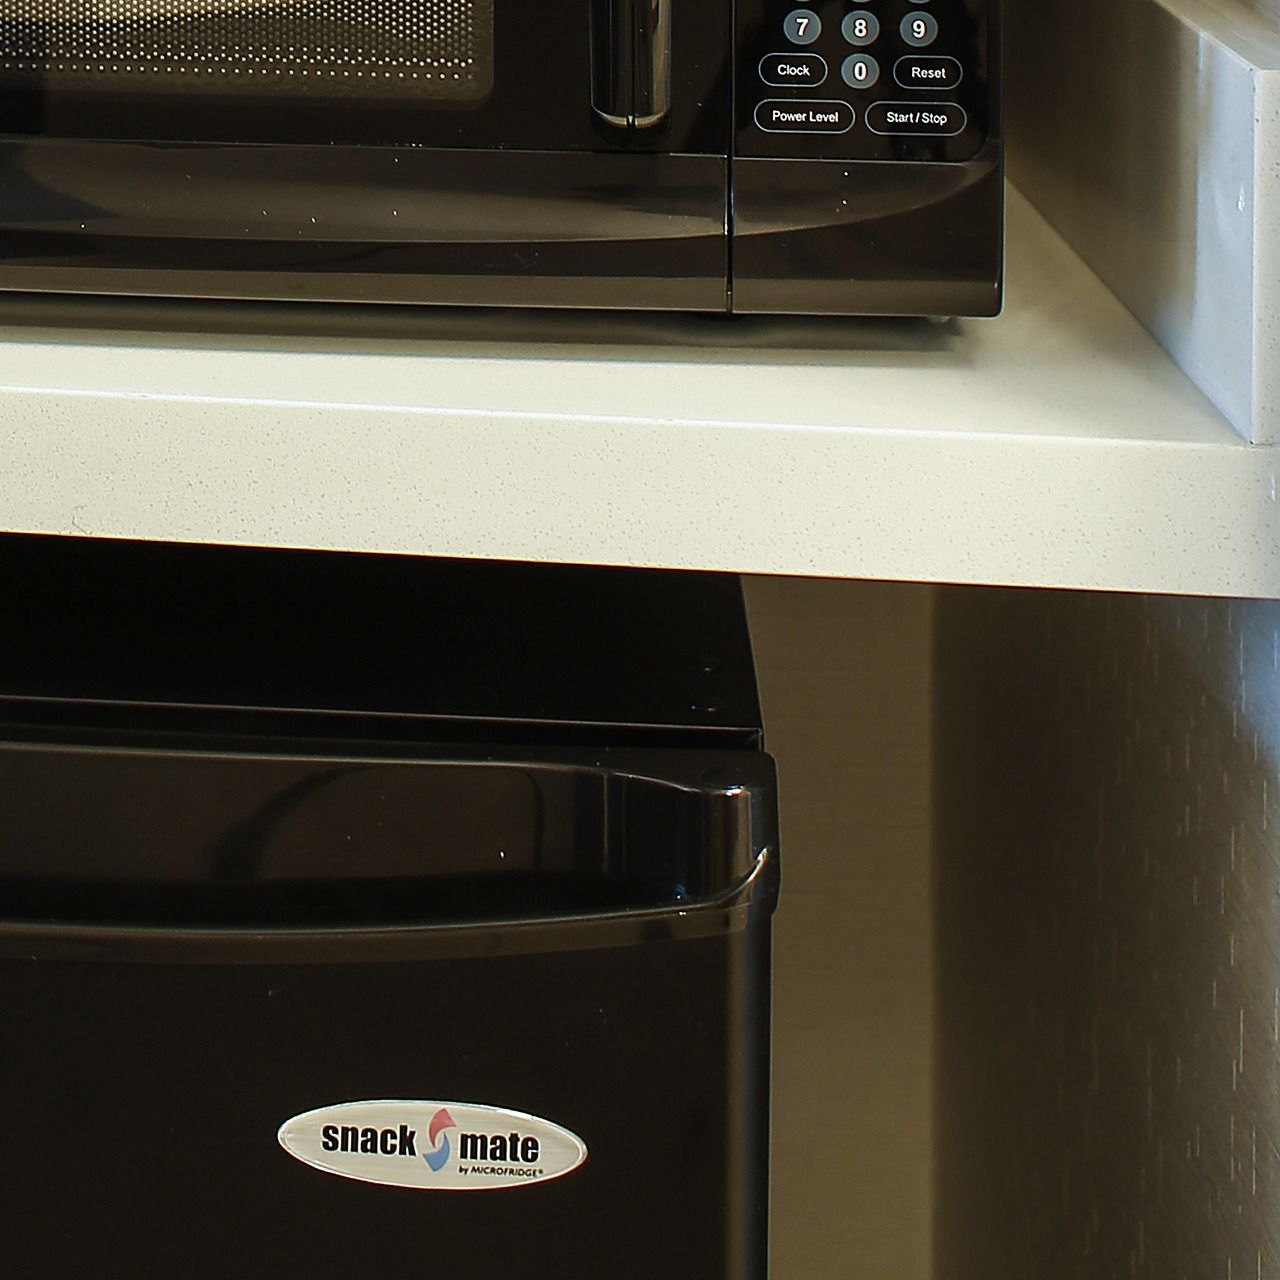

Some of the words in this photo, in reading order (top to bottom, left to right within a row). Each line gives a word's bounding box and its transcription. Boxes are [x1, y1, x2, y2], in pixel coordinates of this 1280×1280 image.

[796, 18, 808, 36] 7
[854, 19, 867, 37] 8
[912, 20, 925, 38] 9
[776, 63, 811, 77] Clock
[854, 62, 867, 80] 0
[911, 66, 947, 80] Reset
[771, 110, 808, 123] Power
[809, 111, 840, 124] Level
[885, 111, 915, 124] Start
[921, 112, 949, 126] Stop
[320, 1122, 418, 1157] snack
[458, 1130, 541, 1164] mate
[458, 1164, 469, 1176] by
